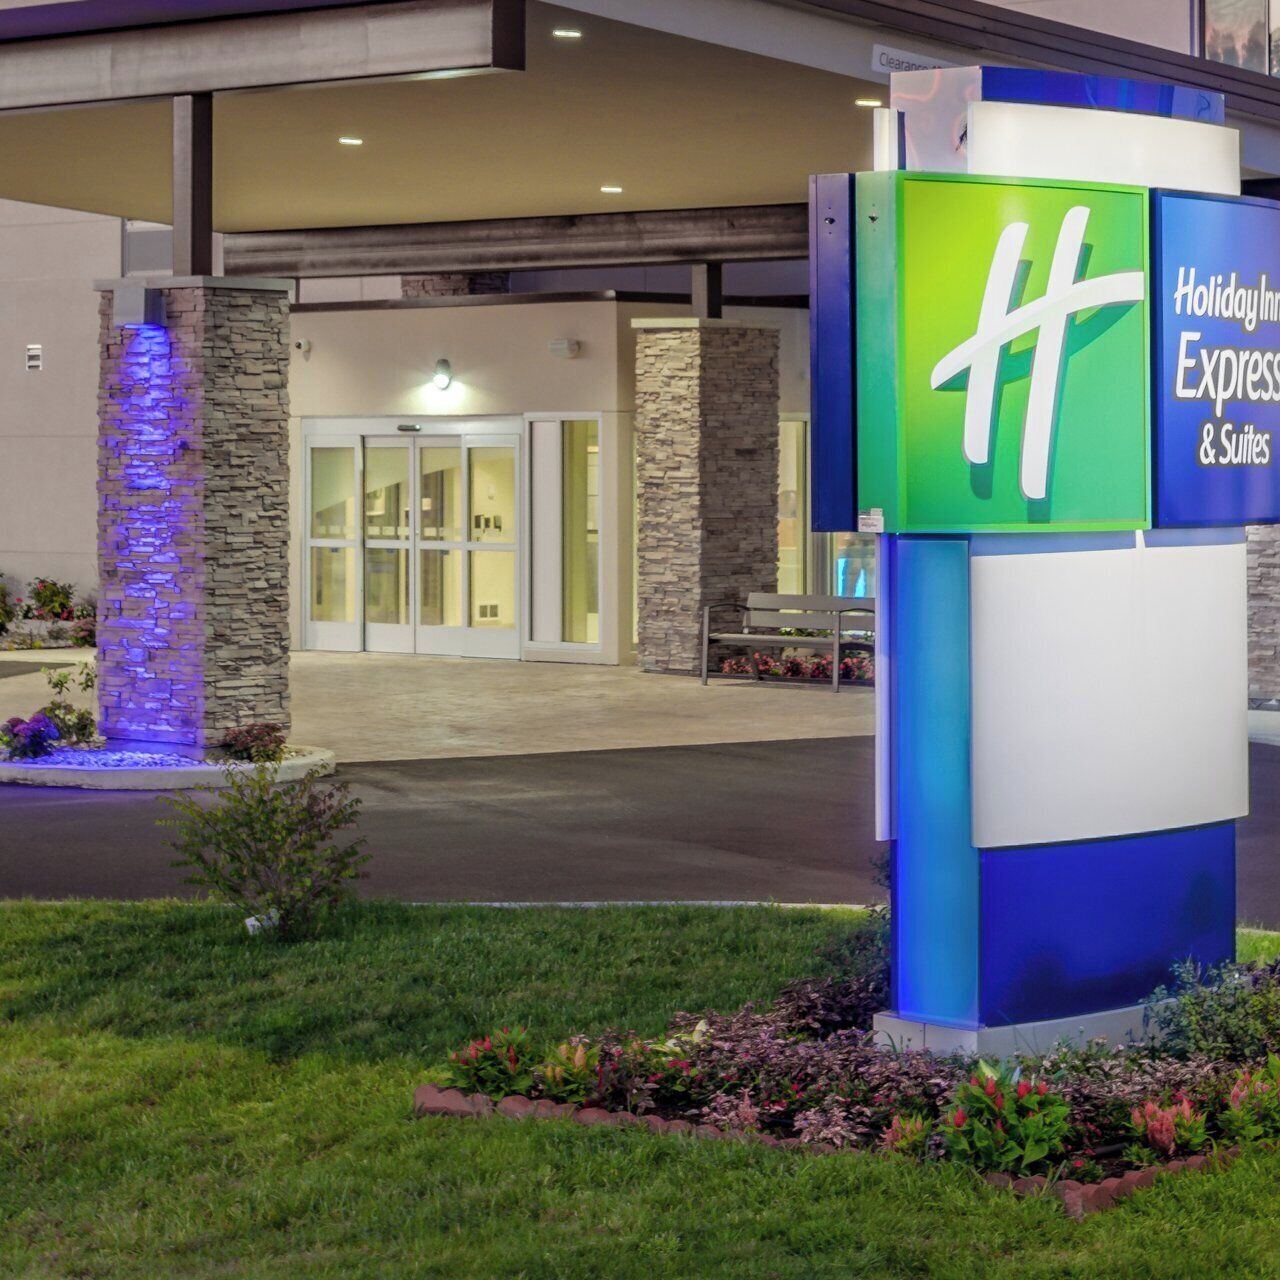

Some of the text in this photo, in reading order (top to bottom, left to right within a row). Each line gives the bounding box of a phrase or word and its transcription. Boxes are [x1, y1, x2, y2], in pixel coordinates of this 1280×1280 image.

[1174, 266, 1259, 332] Holiday
[1199, 422, 1270, 465] & Suites
